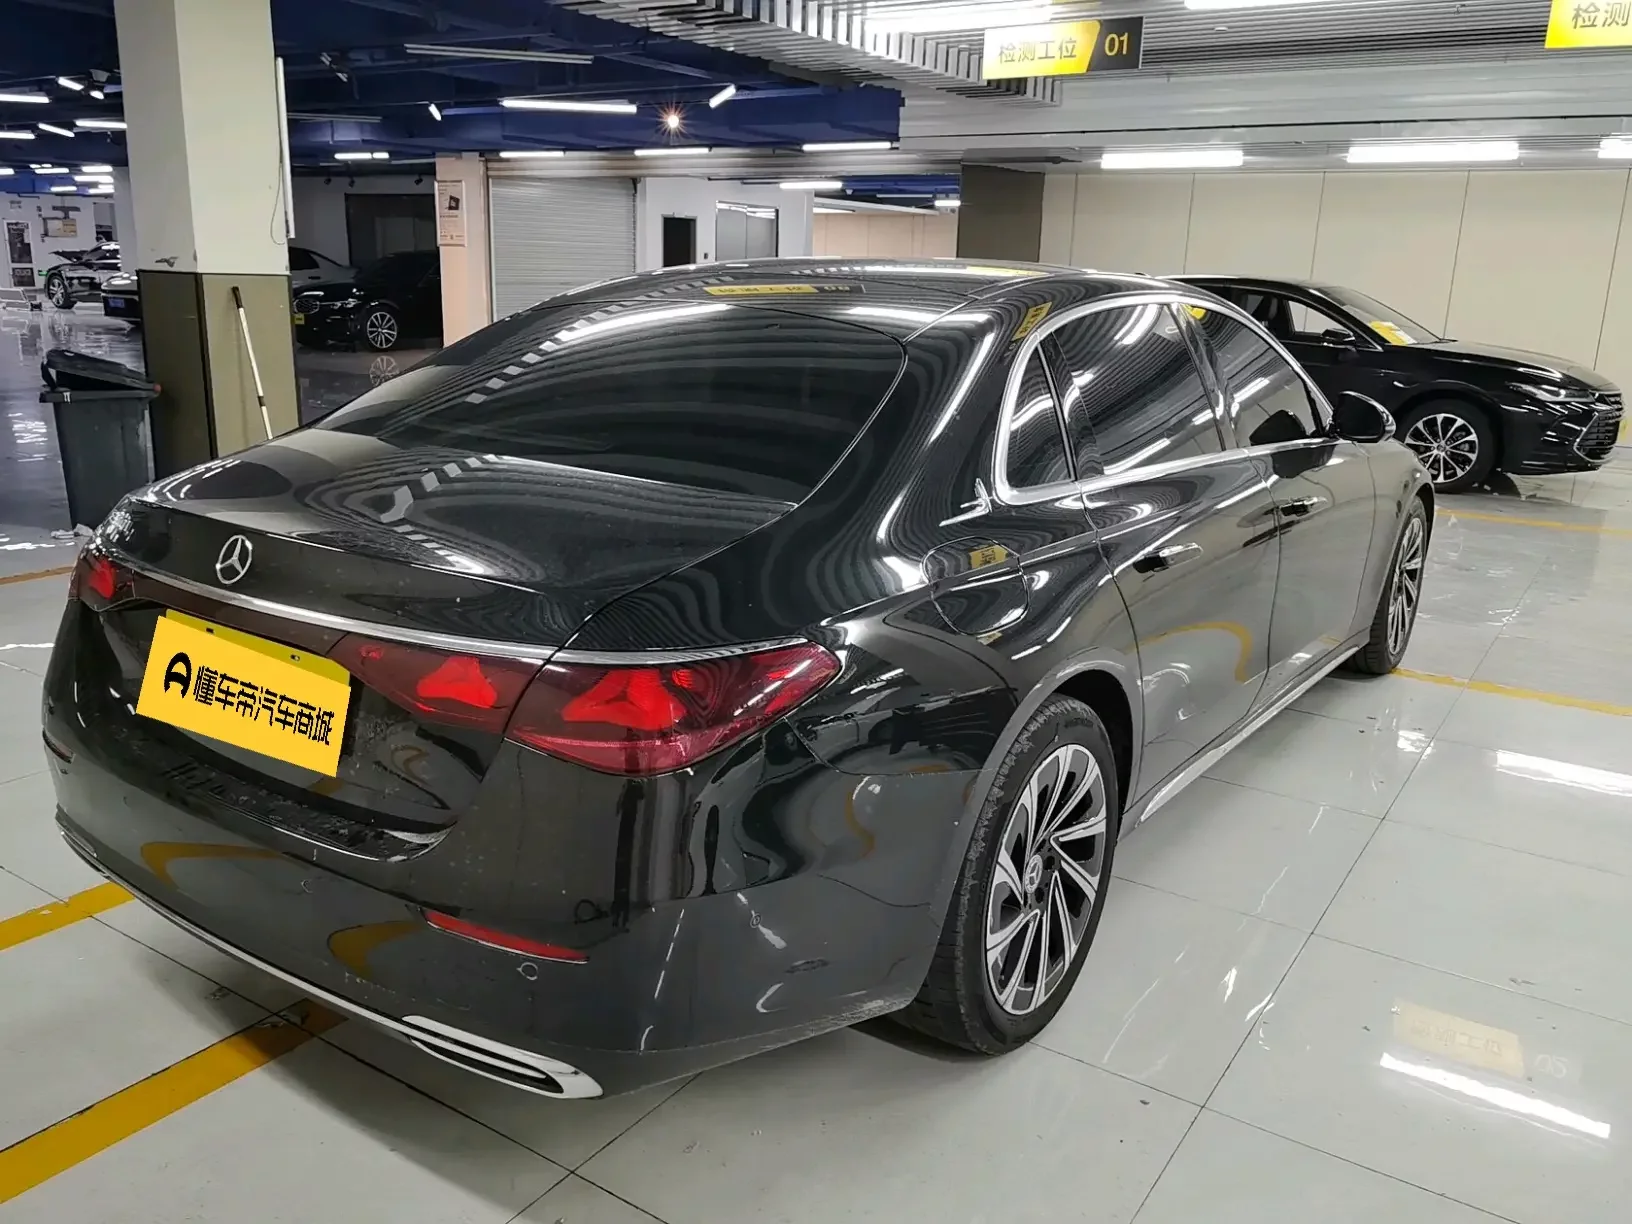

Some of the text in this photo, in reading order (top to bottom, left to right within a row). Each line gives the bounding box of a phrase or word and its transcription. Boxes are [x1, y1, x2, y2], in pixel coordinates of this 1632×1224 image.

[1572, 1, 1632, 30] 检测
[998, 32, 1129, 64] 检测工位 01
